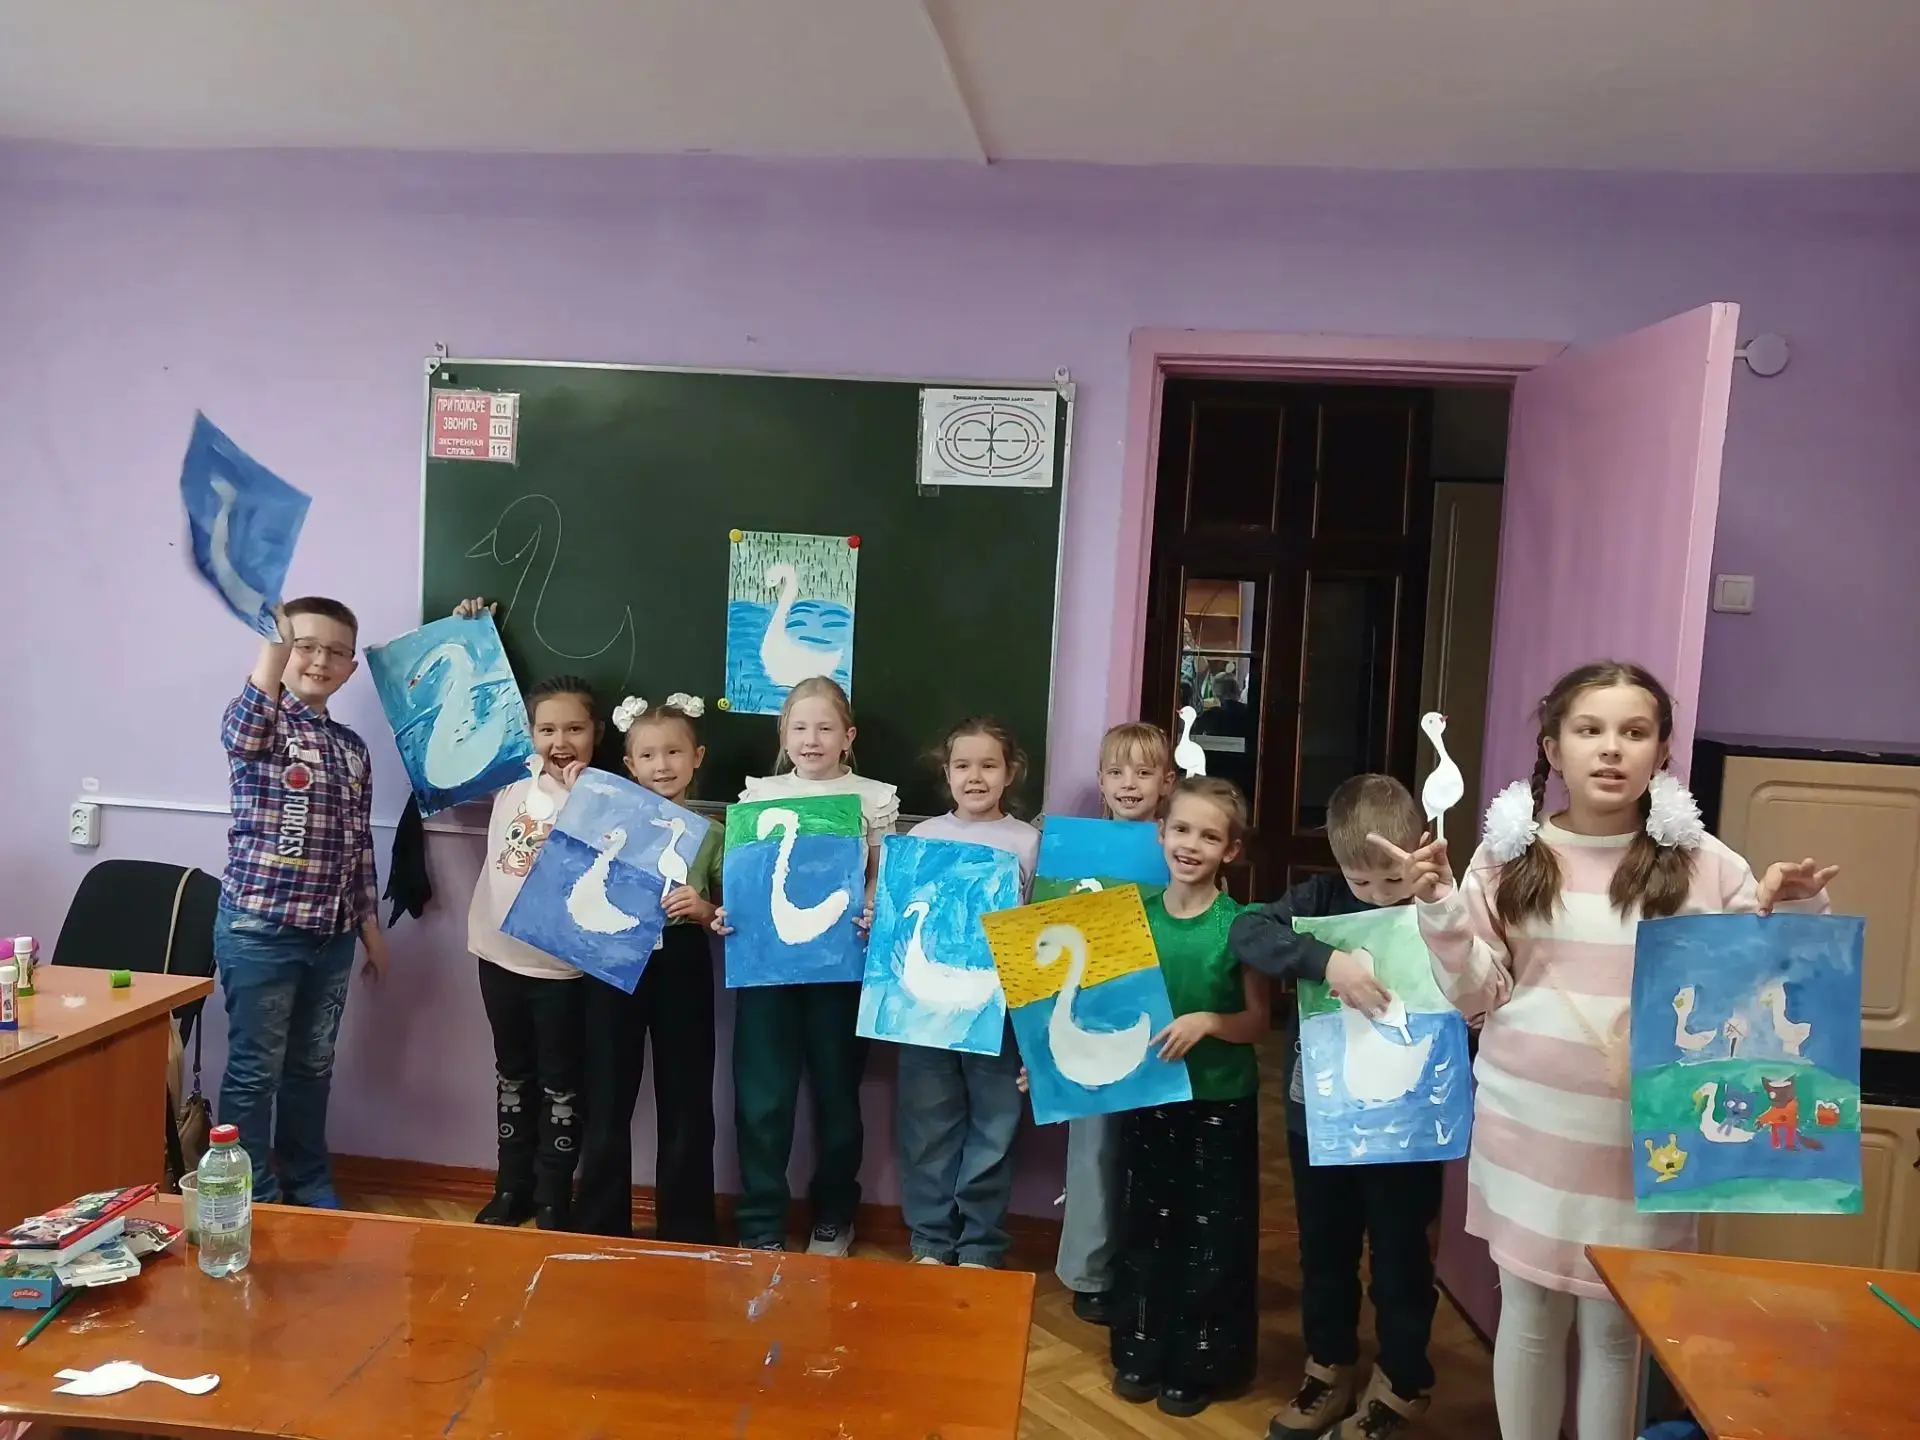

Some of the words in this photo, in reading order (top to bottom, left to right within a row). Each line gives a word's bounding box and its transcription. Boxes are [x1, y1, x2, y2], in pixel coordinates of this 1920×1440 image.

[437, 398, 453, 412] ПРИ
[454, 399, 486, 413] ПОЖАРЕ
[495, 403, 507, 414] 01
[443, 416, 478, 431] ЗВОНИТЬ
[492, 424, 509, 436] 101
[446, 447, 476, 456] СЛУЖБА
[491, 445, 508, 456] 112
[279, 794, 310, 857] FORCES
